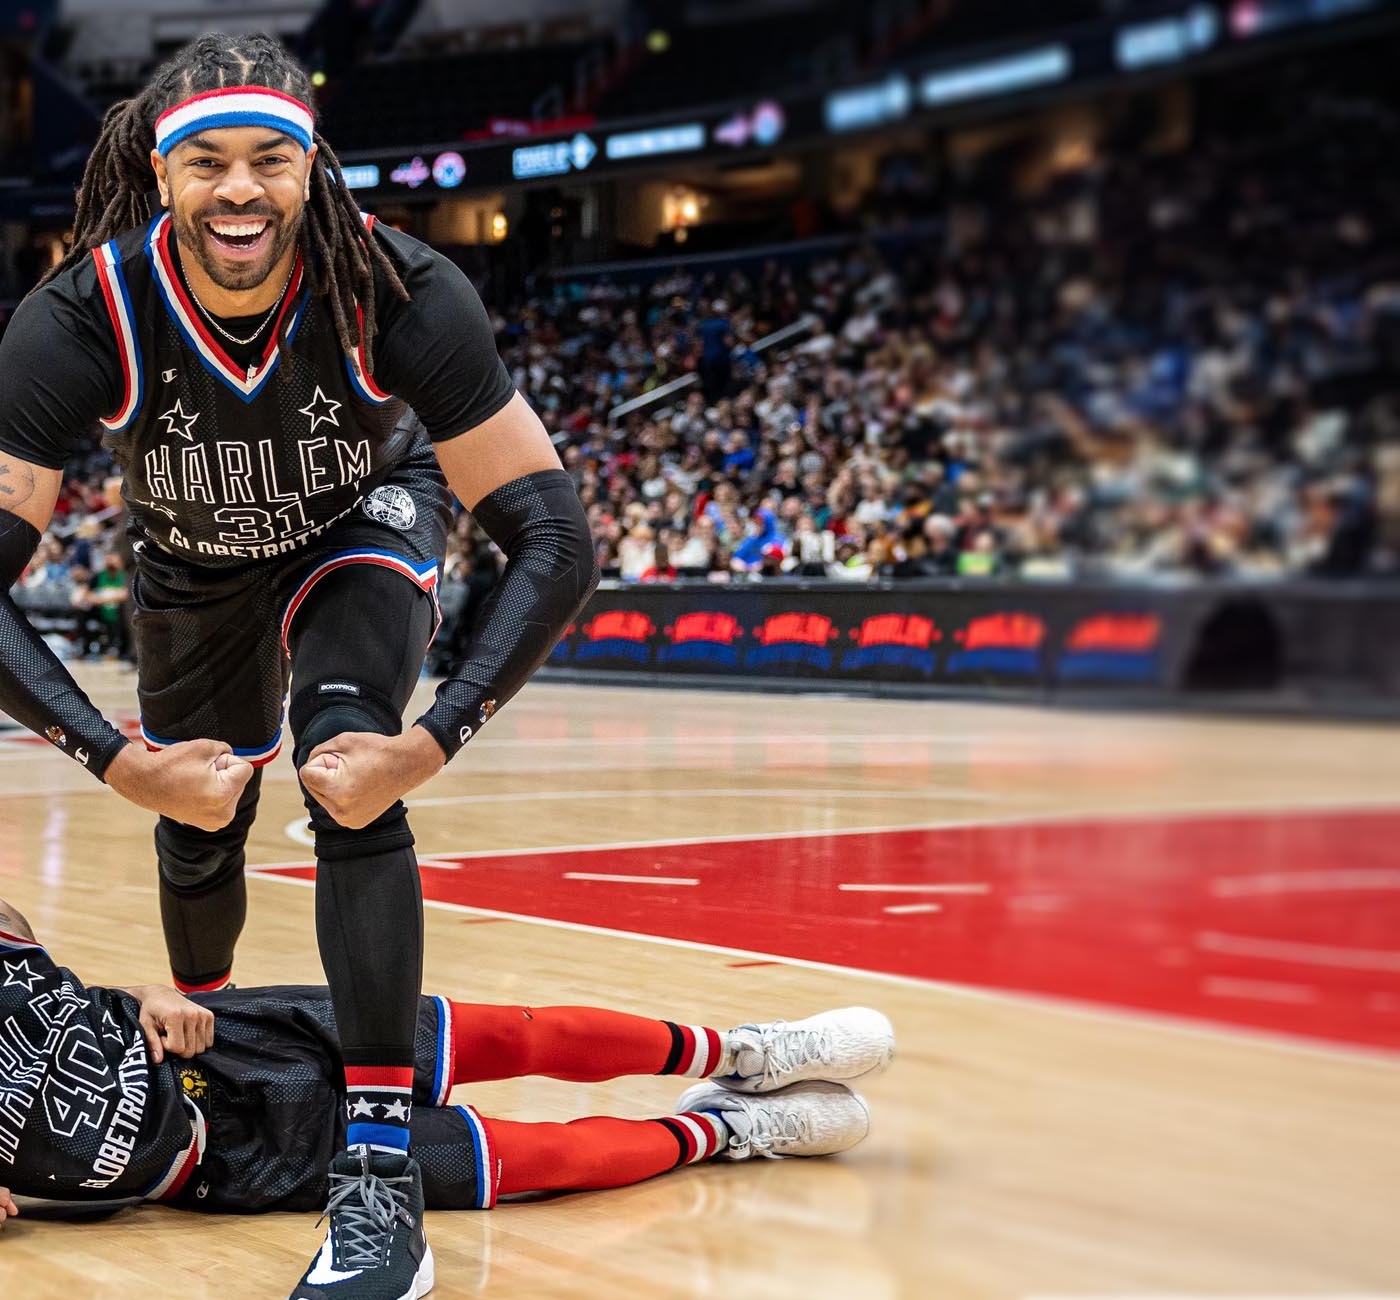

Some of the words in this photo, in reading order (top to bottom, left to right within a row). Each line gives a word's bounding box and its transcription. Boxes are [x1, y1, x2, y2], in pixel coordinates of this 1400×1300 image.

[145, 436, 371, 504] HARLEM
[214, 500, 315, 544] 31
[42, 1024, 117, 1138] 40
